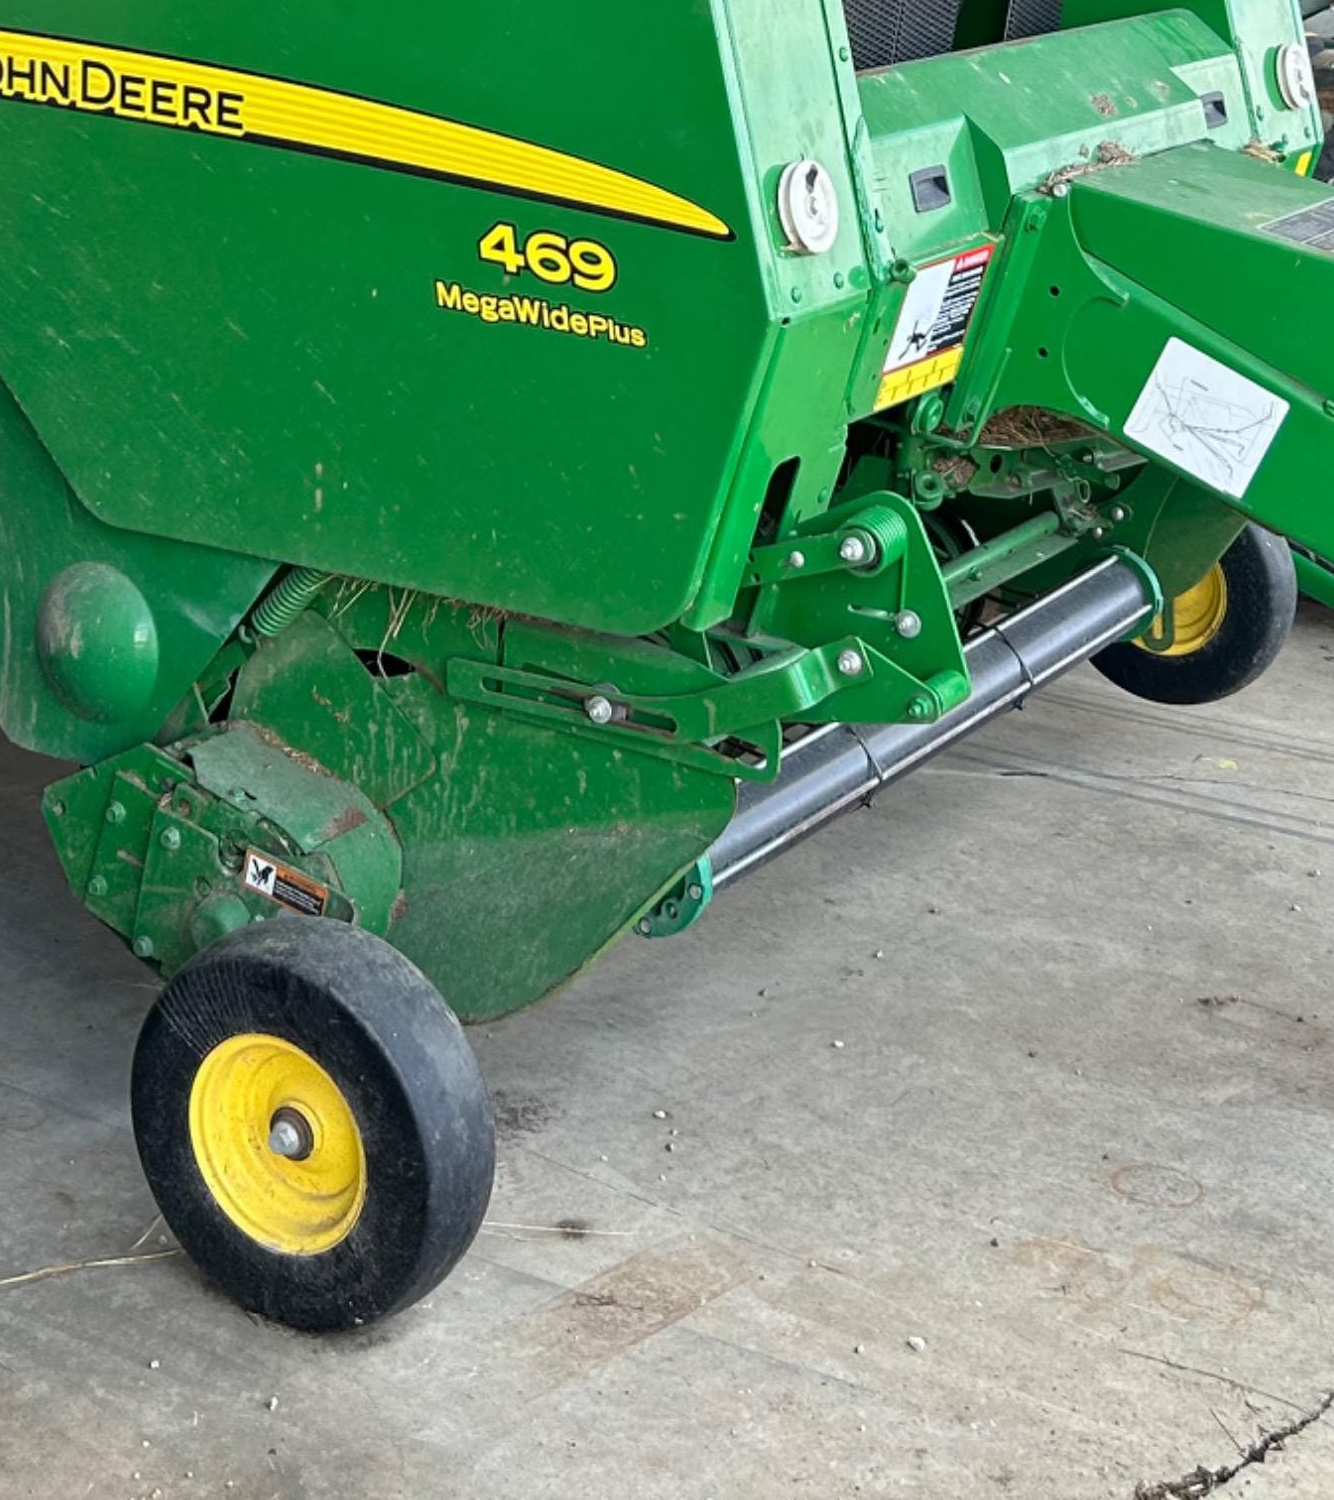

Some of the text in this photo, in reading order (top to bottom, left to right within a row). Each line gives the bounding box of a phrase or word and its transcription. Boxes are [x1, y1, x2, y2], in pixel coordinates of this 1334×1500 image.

[81, 59, 245, 130] DEERE
[478, 222, 616, 292] 469
[435, 280, 647, 347] MegaWidePlus
